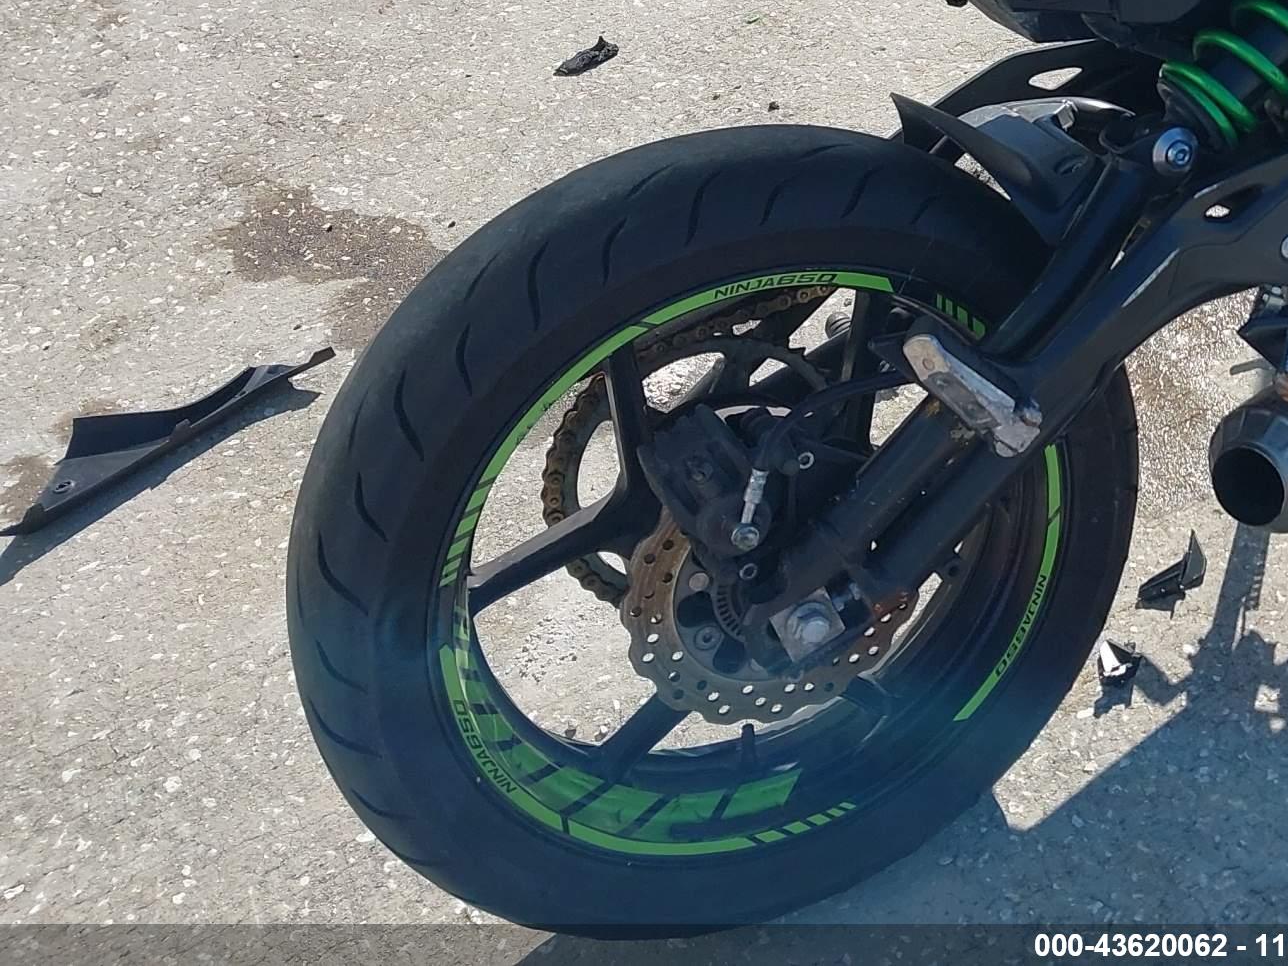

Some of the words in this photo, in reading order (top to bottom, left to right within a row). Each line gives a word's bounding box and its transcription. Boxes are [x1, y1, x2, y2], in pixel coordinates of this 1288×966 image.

[714, 273, 838, 299] NINJA650
[995, 574, 1047, 677] NINJA650
[452, 699, 518, 794] NINJA650
